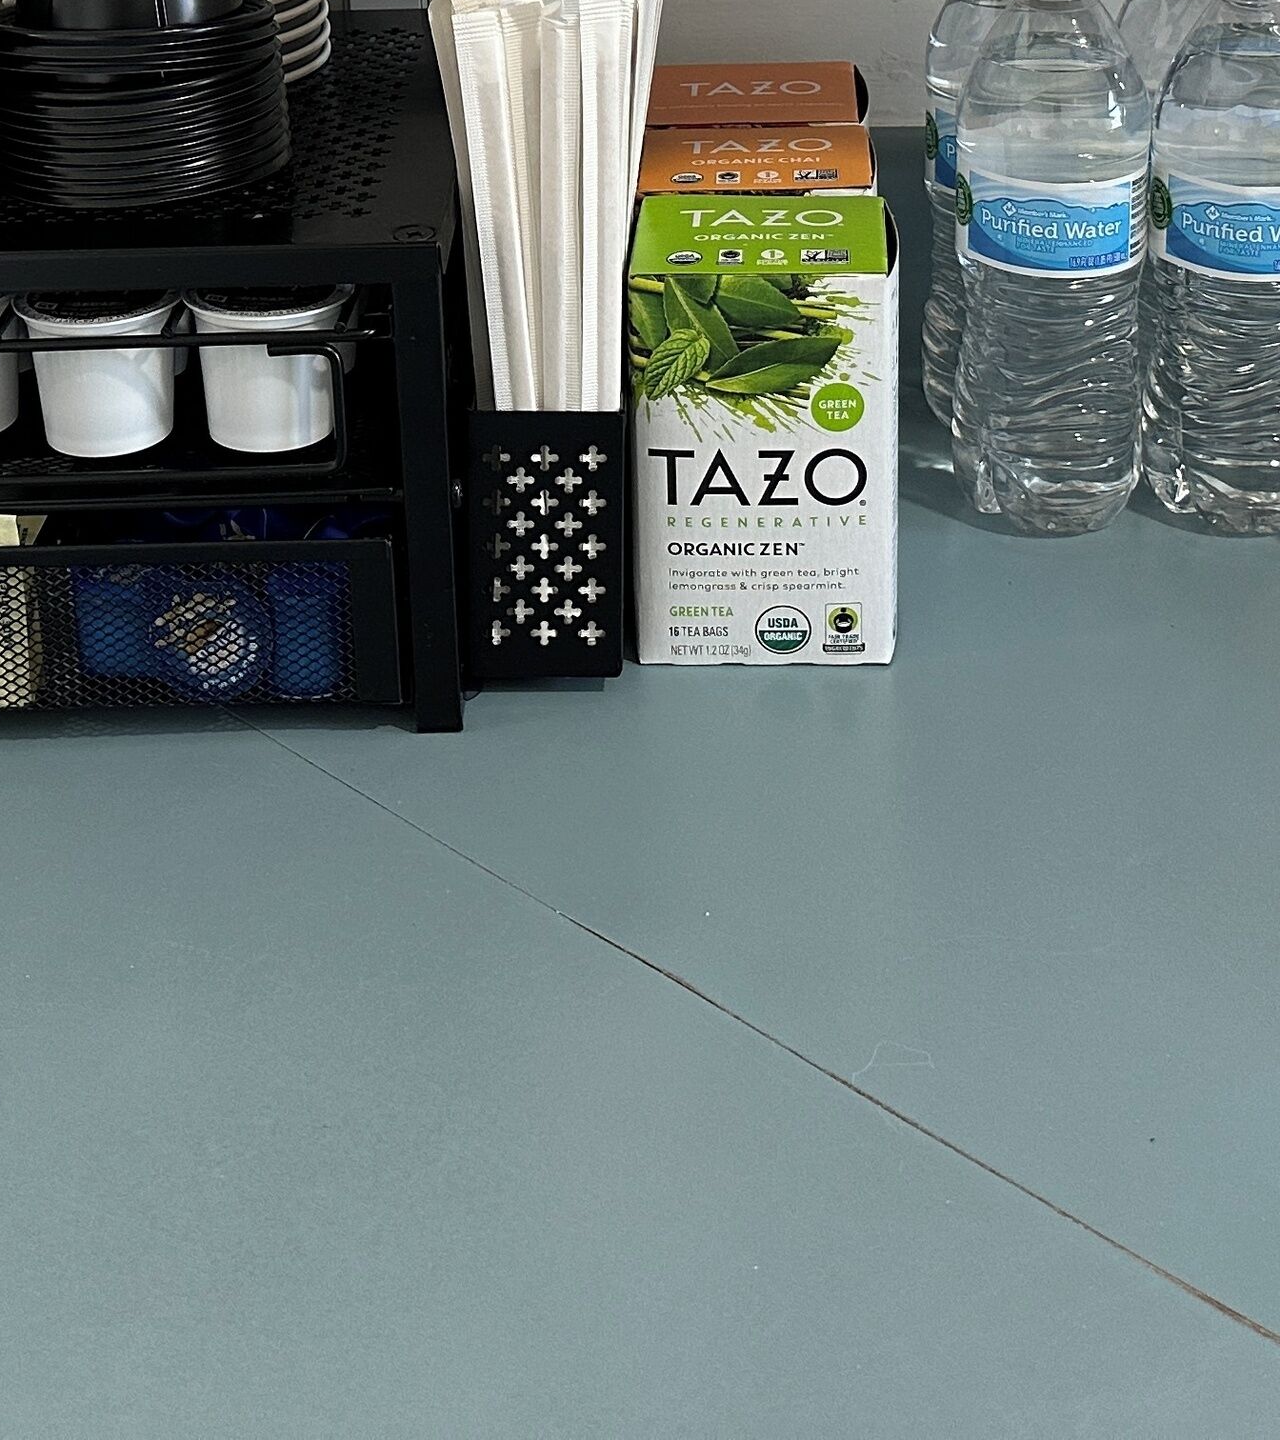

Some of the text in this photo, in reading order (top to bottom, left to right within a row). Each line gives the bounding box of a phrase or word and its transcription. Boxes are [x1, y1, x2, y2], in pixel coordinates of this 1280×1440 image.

[680, 79, 822, 98] TAZO
[681, 137, 833, 155] TAZO
[690, 156, 821, 166] ORGANIC CHAI
[679, 208, 844, 228] TAZO
[980, 206, 1122, 241] Purified Water
[1181, 211, 1264, 243] Purified
[693, 232, 784, 241] ORGANIC
[818, 398, 857, 409] GREEN
[826, 410, 850, 420] TEA
[647, 448, 868, 507] TAZO
[666, 514, 867, 528] REGENERATIVE
[667, 542, 756, 557] ORGANIC
[668, 567, 860, 580] Invigorate with green tea, bright
[668, 581, 846, 592] lemongrass & crisp spearmint.
[669, 606, 734, 617] GREEN TEA
[767, 617, 798, 629] USDA
[668, 626, 729, 637] 16 TEA BAGS
[763, 631, 803, 641] ORGANIC
[670, 643, 752, 658] NET WT 1.2 OZ (34g)
